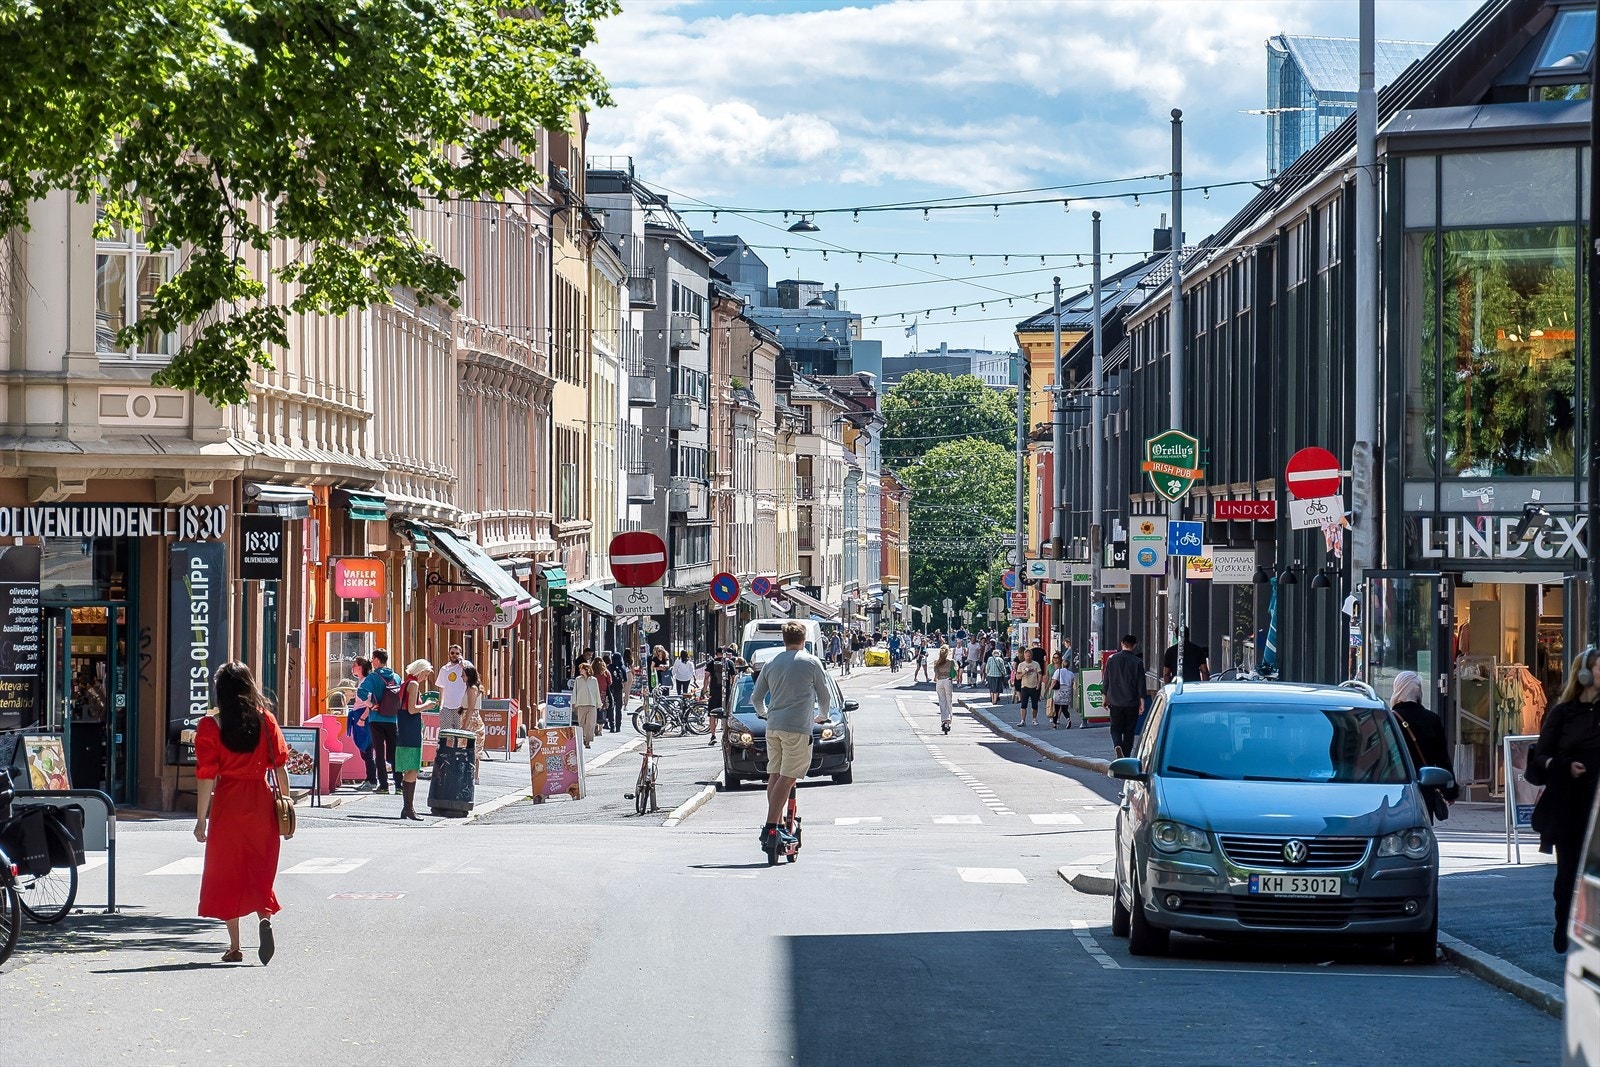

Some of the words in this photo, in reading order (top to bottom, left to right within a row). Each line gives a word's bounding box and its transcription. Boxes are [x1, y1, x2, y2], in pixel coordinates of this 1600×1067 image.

[1153, 462, 1174, 475] IRISH
[1176, 468, 1191, 478] PUB
[1220, 505, 1270, 514] LINDEX
[0, 506, 153, 537] OLIVENLUNDEN
[343, 570, 376, 578] VAFLER
[9, 588, 38, 596] olivenolje
[8, 607, 38, 615] pistasjkrem
[190, 556, 209, 658] OLJESLIPP
[625, 605, 654, 613] unntatt
[3, 625, 38, 634] basilikumolje
[12, 644, 38, 652] tapenade
[15, 663, 36, 671] pepper
[1262, 878, 1283, 892] KH
[1291, 878, 1336, 892] 53012
